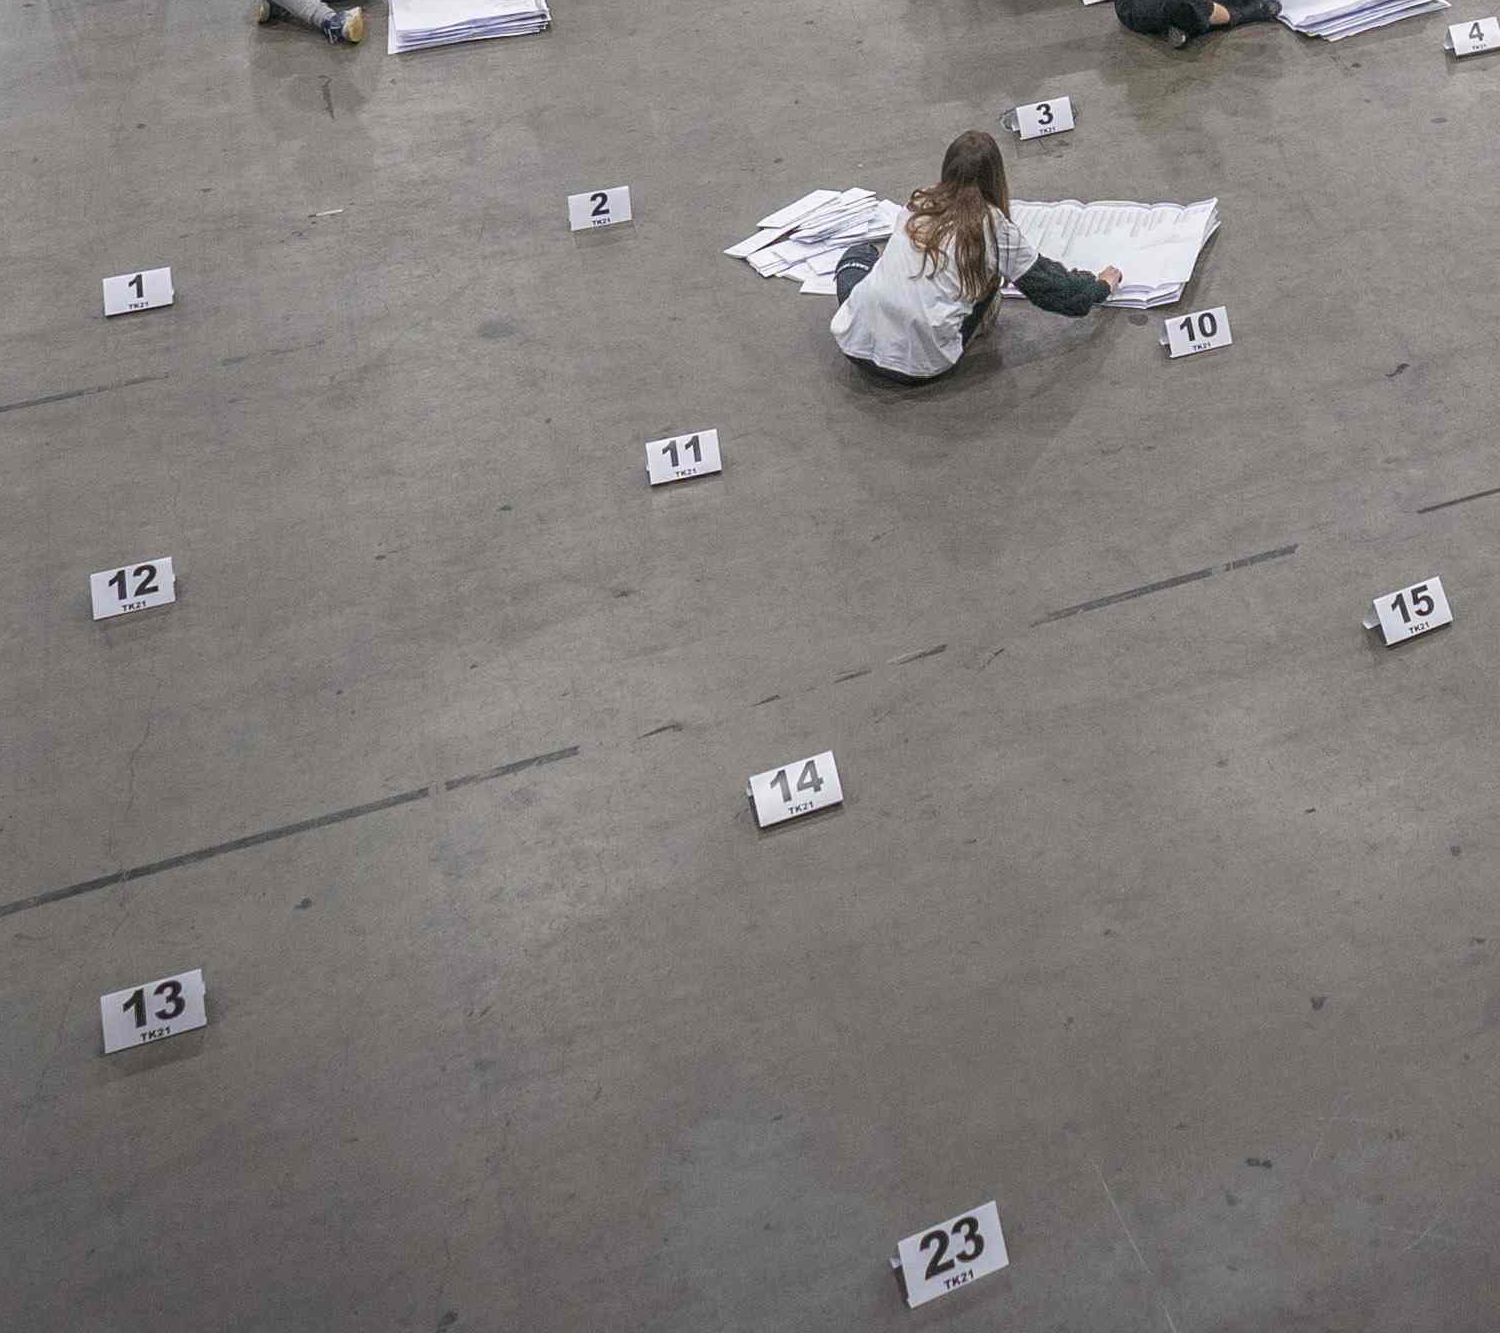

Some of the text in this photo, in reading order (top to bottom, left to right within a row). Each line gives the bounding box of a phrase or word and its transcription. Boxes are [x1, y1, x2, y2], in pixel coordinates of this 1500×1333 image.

[1467, 21, 1484, 42] 4
[1036, 104, 1053, 125] 3
[590, 192, 609, 216] 2
[129, 274, 143, 298] 1
[1180, 313, 1217, 341] 10
[662, 436, 701, 467] 11
[109, 561, 158, 596] 12
[122, 601, 146, 611] TK21
[1390, 585, 1434, 626] 15
[1410, 622, 1429, 633] TK21
[769, 760, 823, 803] 14
[790, 802, 812, 813] TK21
[123, 981, 185, 1028] 13
[140, 1027, 170, 1041] TK21
[920, 1217, 984, 1282] 23
[944, 1270, 973, 1289] TK21
